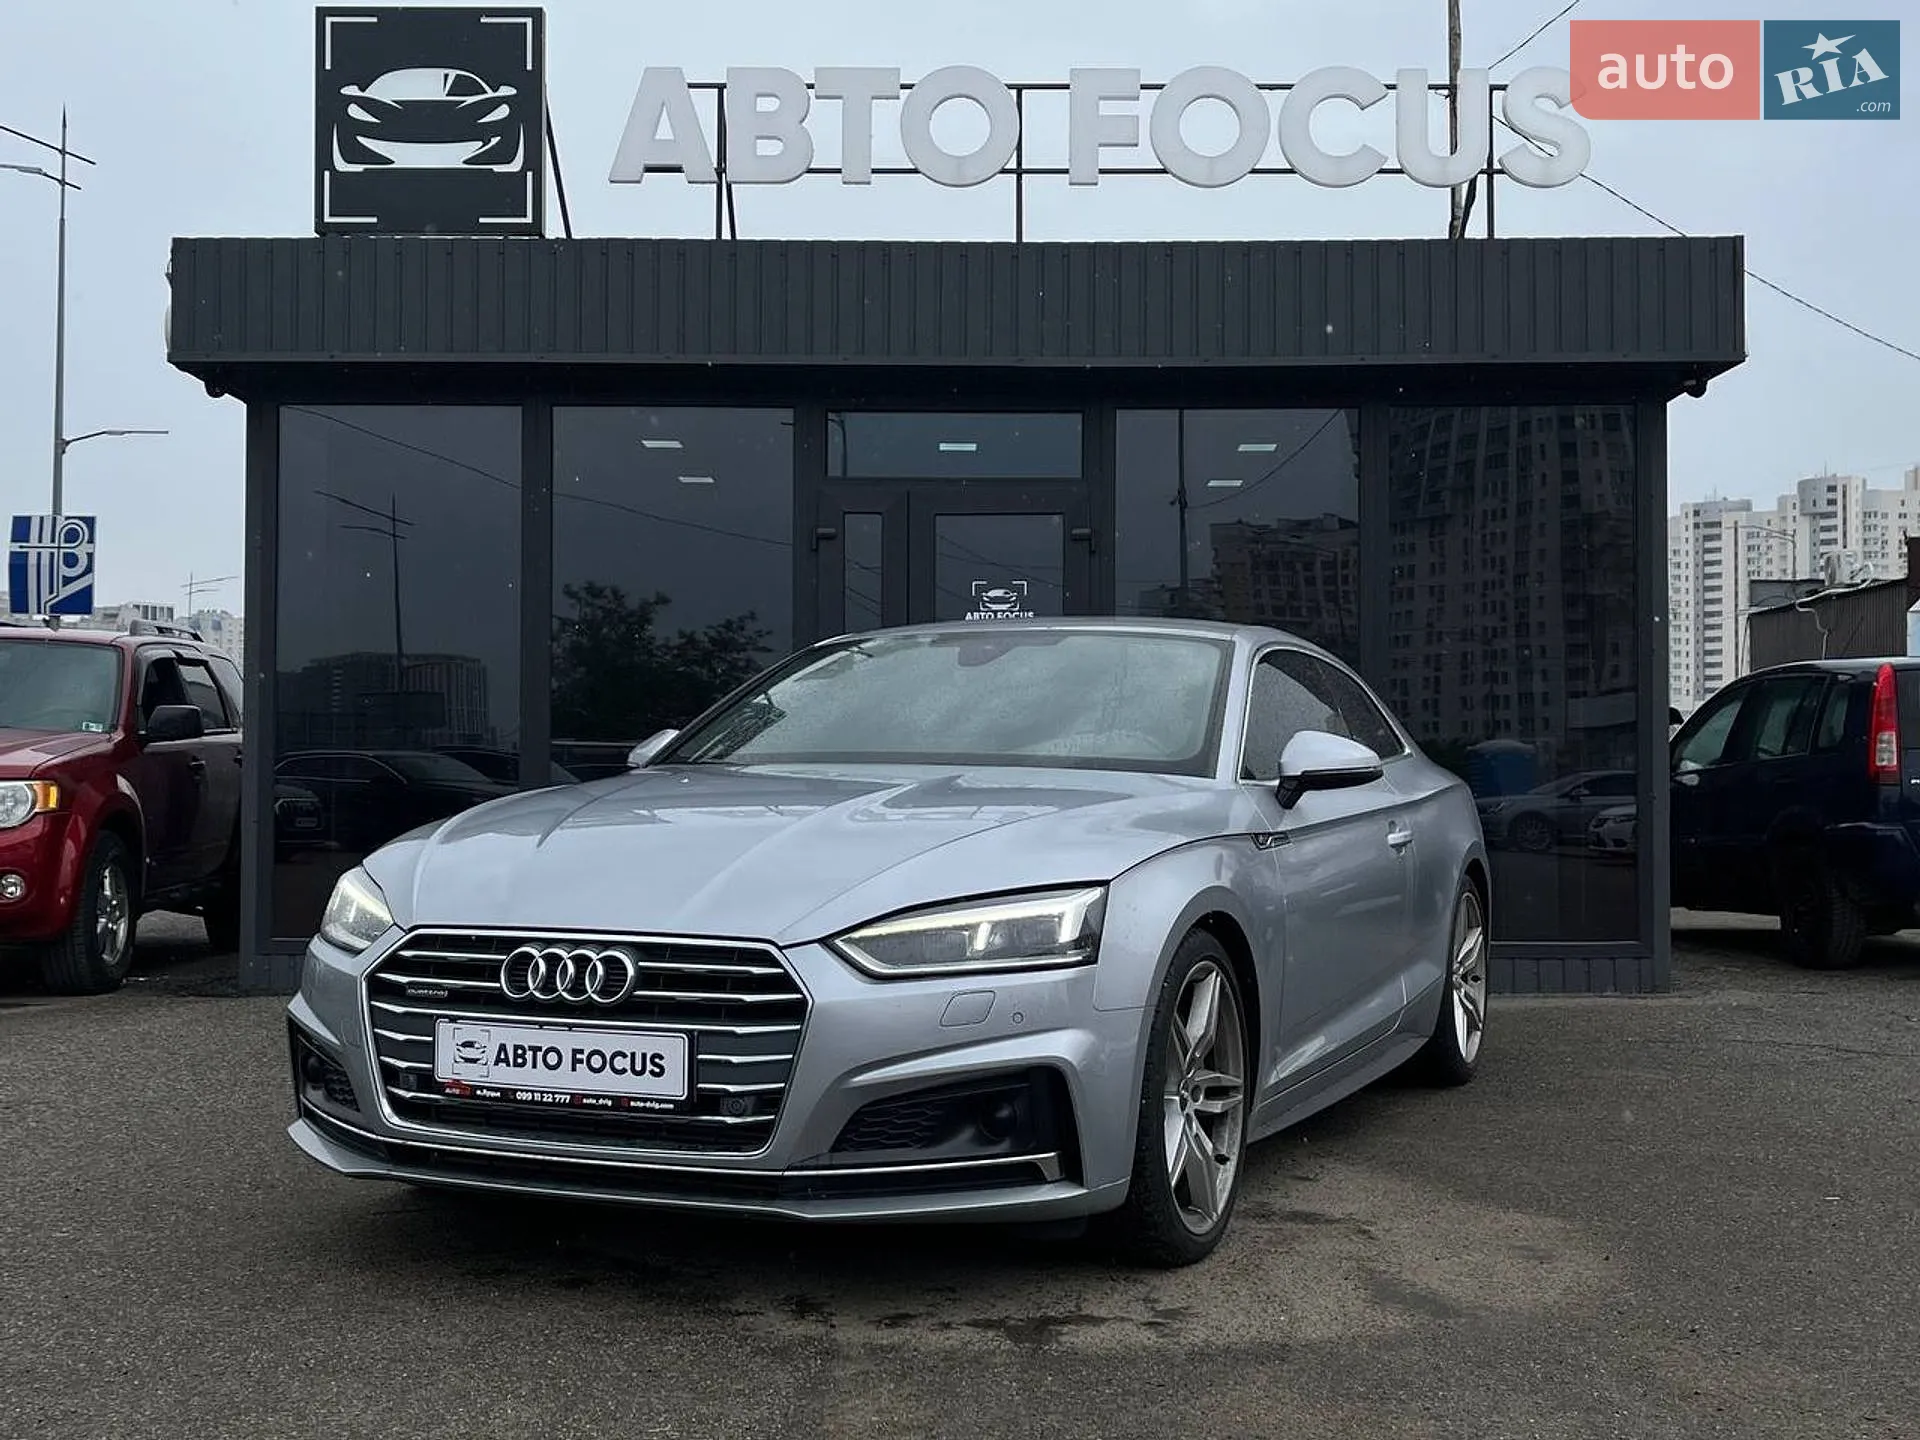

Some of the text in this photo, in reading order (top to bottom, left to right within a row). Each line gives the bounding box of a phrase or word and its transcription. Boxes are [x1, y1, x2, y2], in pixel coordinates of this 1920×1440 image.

[608, 65, 1592, 188] АВТО FOCUS
[494, 1043, 666, 1078] АВТО FOCUS
[516, 1091, 571, 1103] 099 11 22 777
